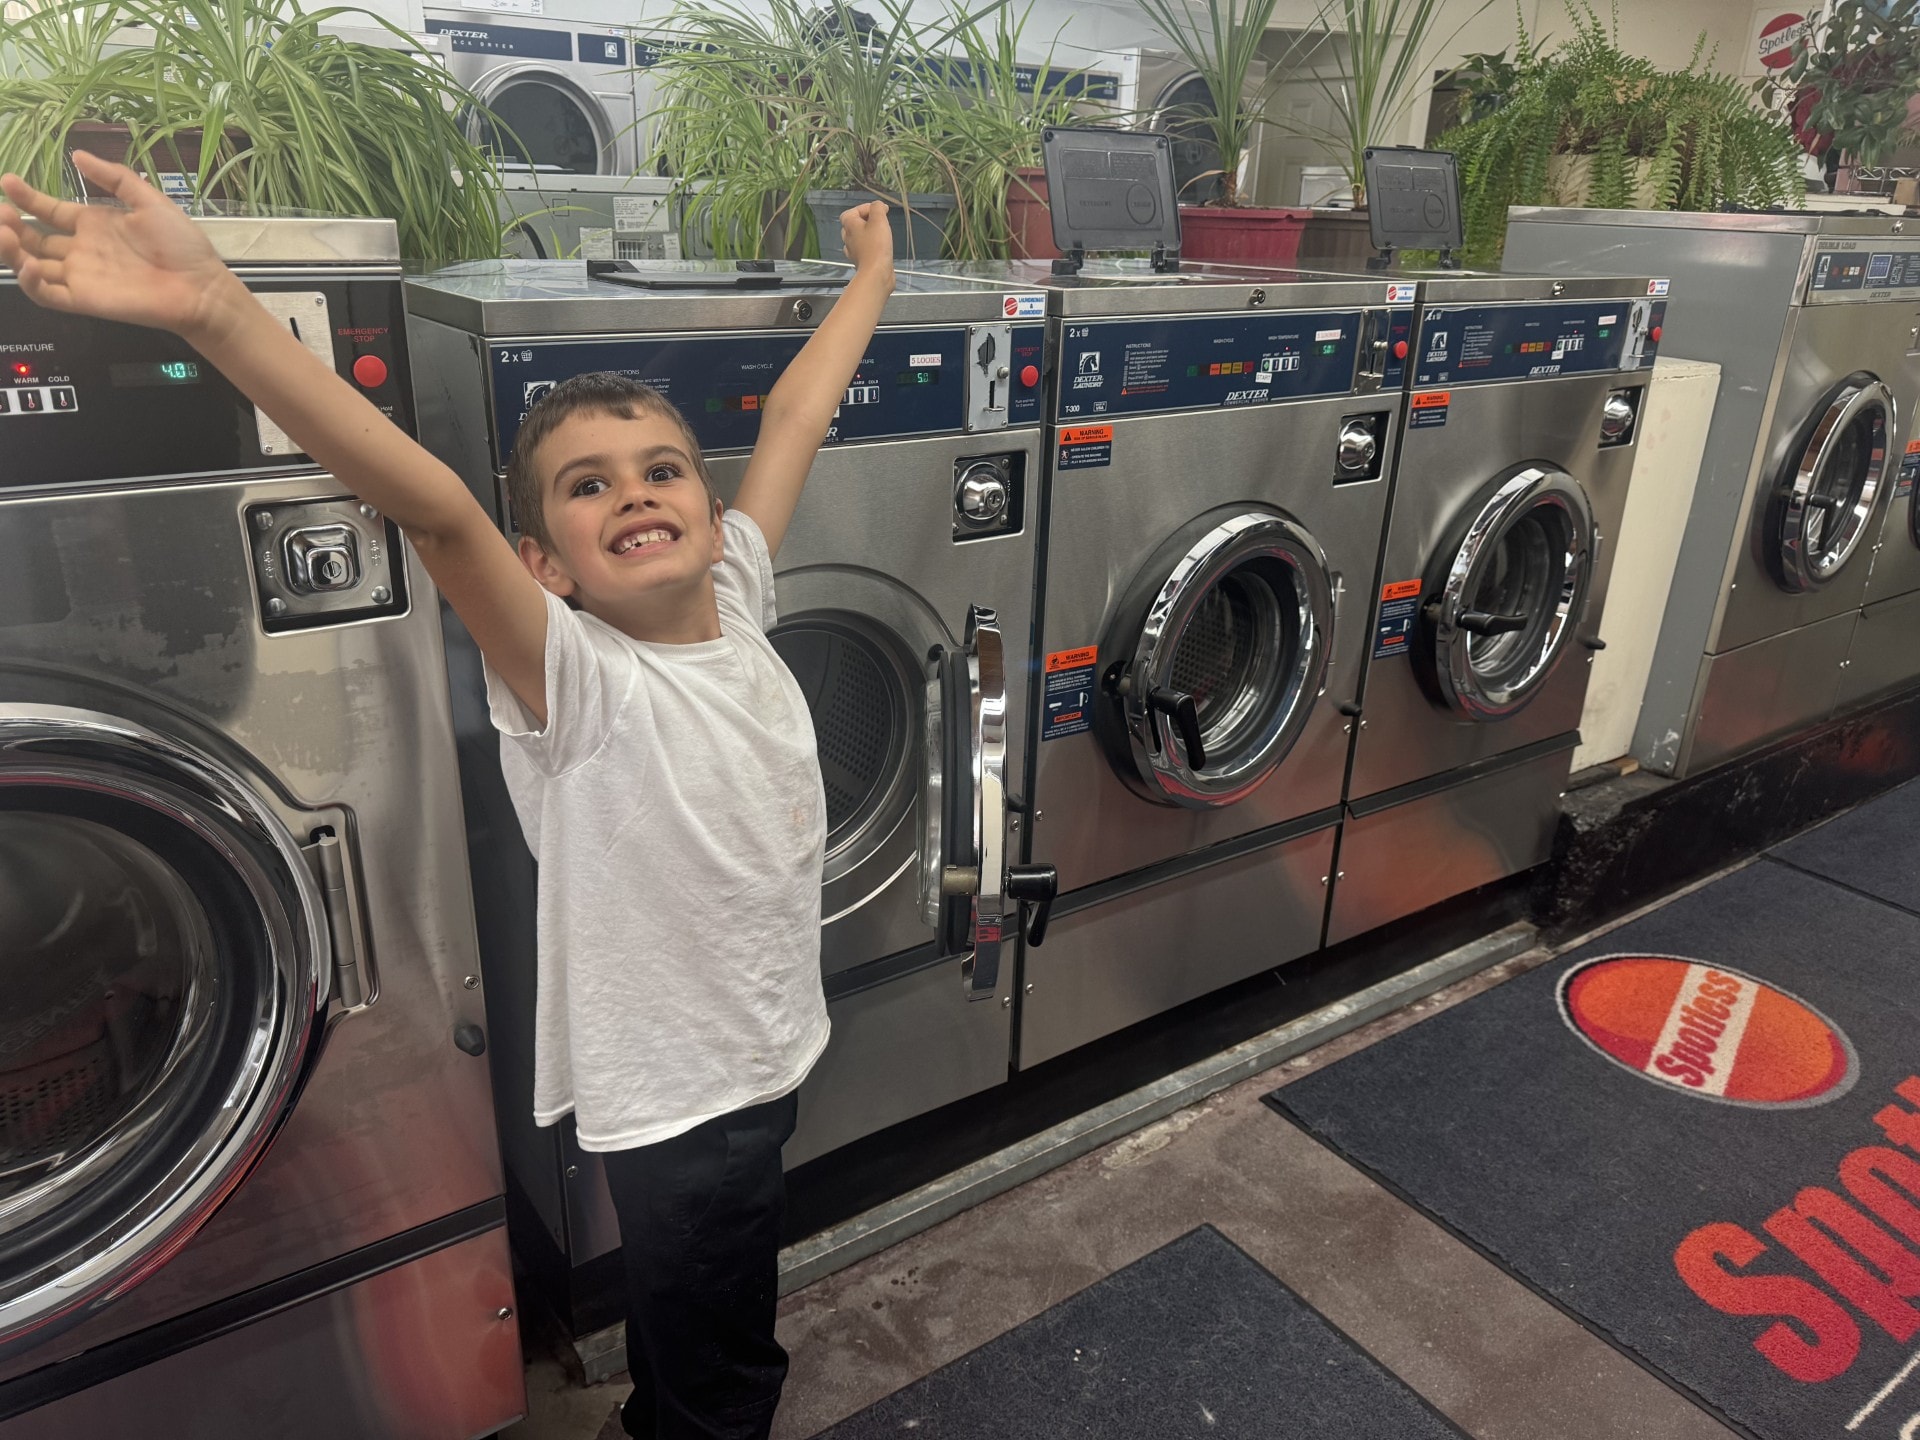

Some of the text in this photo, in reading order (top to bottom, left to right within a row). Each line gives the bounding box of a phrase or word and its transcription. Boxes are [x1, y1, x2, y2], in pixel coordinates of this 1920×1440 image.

[439, 28, 489, 39] DEXTER
[480, 41, 514, 49] DRYER
[337, 327, 389, 336] EMERGENCY
[1069, 328, 1075, 338] 2
[353, 335, 375, 343] STOP
[501, 350, 519, 363] 2 x
[911, 357, 916, 365] 5
[1529, 364, 1561, 375] DEXTER
[13, 376, 39, 385] WARM
[48, 375, 70, 383] COLD
[1073, 375, 1104, 383] DEXTER
[1072, 381, 1104, 389] LAUNDRY
[1225, 388, 1269, 401] DEXTER
[1065, 404, 1080, 413] T-300
[1065, 651, 1090, 660] WARNING
[1653, 969, 1743, 1087] Spotless
